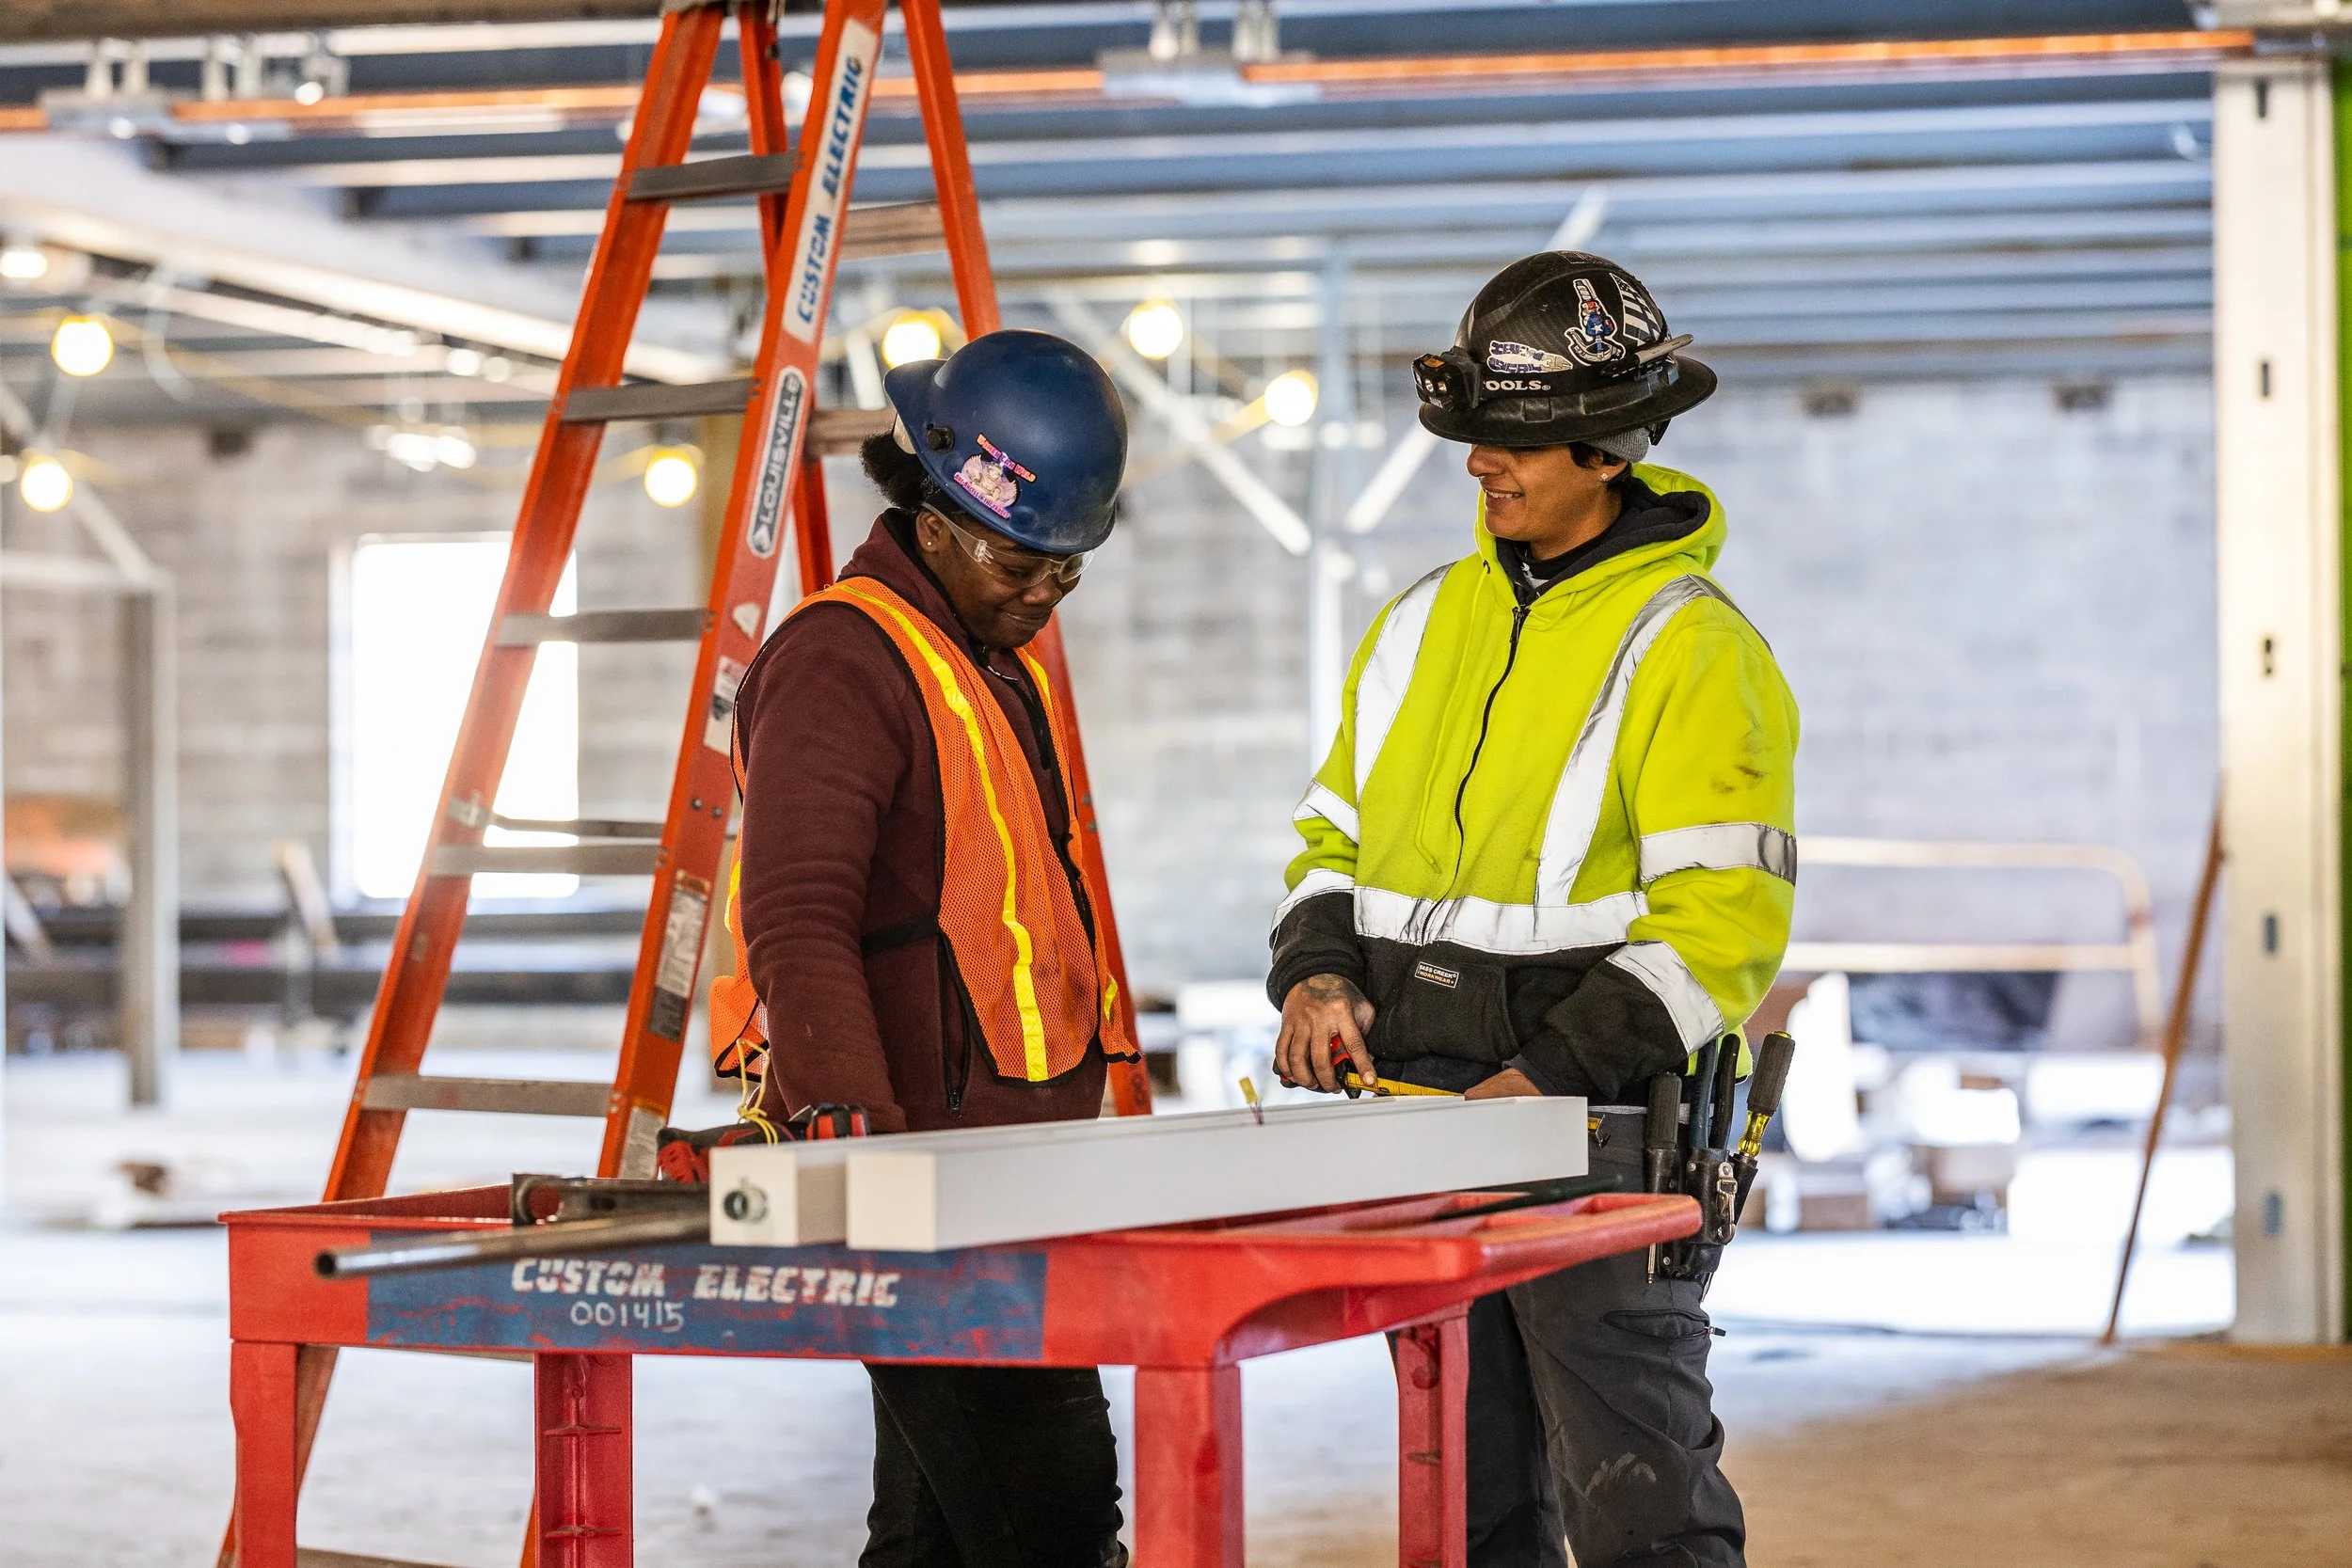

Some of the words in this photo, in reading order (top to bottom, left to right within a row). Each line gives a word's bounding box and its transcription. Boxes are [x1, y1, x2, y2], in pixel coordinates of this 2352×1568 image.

[798, 214, 832, 324] CUSTOM
[822, 55, 863, 198] ELECTRIC
[759, 372, 800, 527] LOUISVILLE
[511, 1258, 666, 1296] CUSTOM
[692, 1263, 901, 1307] ELECTRIC
[570, 1300, 684, 1332] 001415
